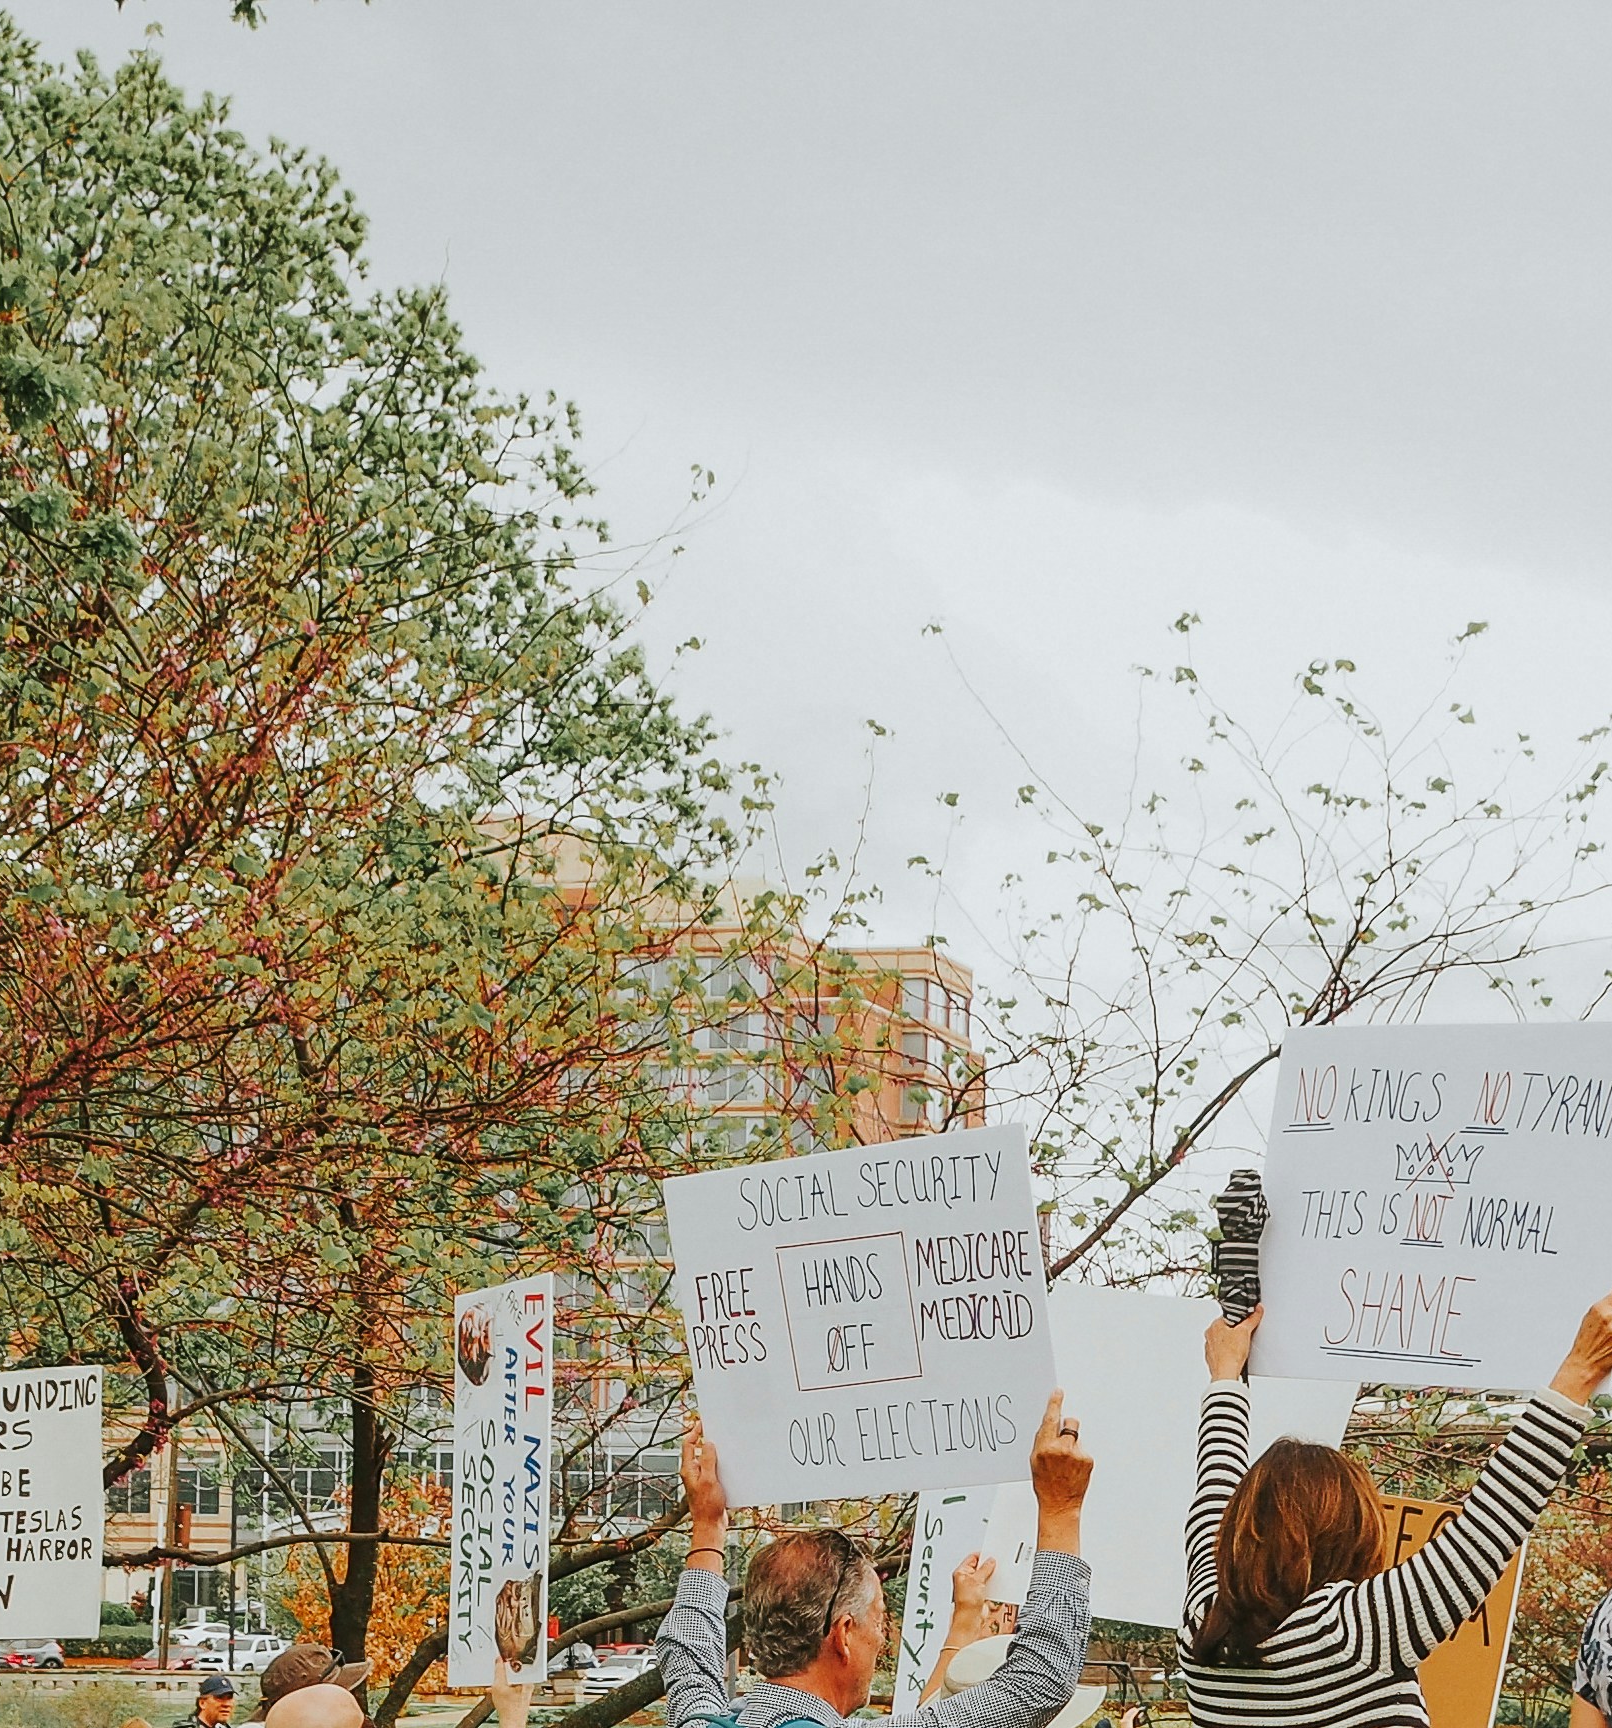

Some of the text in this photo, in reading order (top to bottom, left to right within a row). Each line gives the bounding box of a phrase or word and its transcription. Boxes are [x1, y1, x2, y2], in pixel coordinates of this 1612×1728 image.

[1294, 1065, 1337, 1123] NO
[1345, 1067, 1446, 1124] KINGS
[1473, 1071, 1512, 1126] NO
[737, 1151, 1002, 1231] SOCIAL SECURITY
[1301, 1190, 1558, 1255] THIS IS NOT NORMAL
[802, 1253, 883, 1307] HANDS
[915, 1230, 1032, 1287] MEDICARE
[695, 1268, 756, 1323] FREE
[920, 1290, 1034, 1342] MEDICAID
[1324, 1268, 1476, 1357] SHAME
[692, 1321, 768, 1371] PRESS
[826, 1323, 875, 1374] OFF
[501, 1289, 523, 1567] ARE AFTER YOUR
[523, 1293, 545, 1570] EVIL NAZIS
[789, 1394, 1018, 1467] OUR ELECTIONS
[1, 1469, 31, 1498] BE
[478, 1418, 496, 1607] SOCIAL
[0, 1505, 83, 1535] TESLAS
[6, 1537, 93, 1563] HARBOR
[457, 1449, 477, 1653] SECURITY
